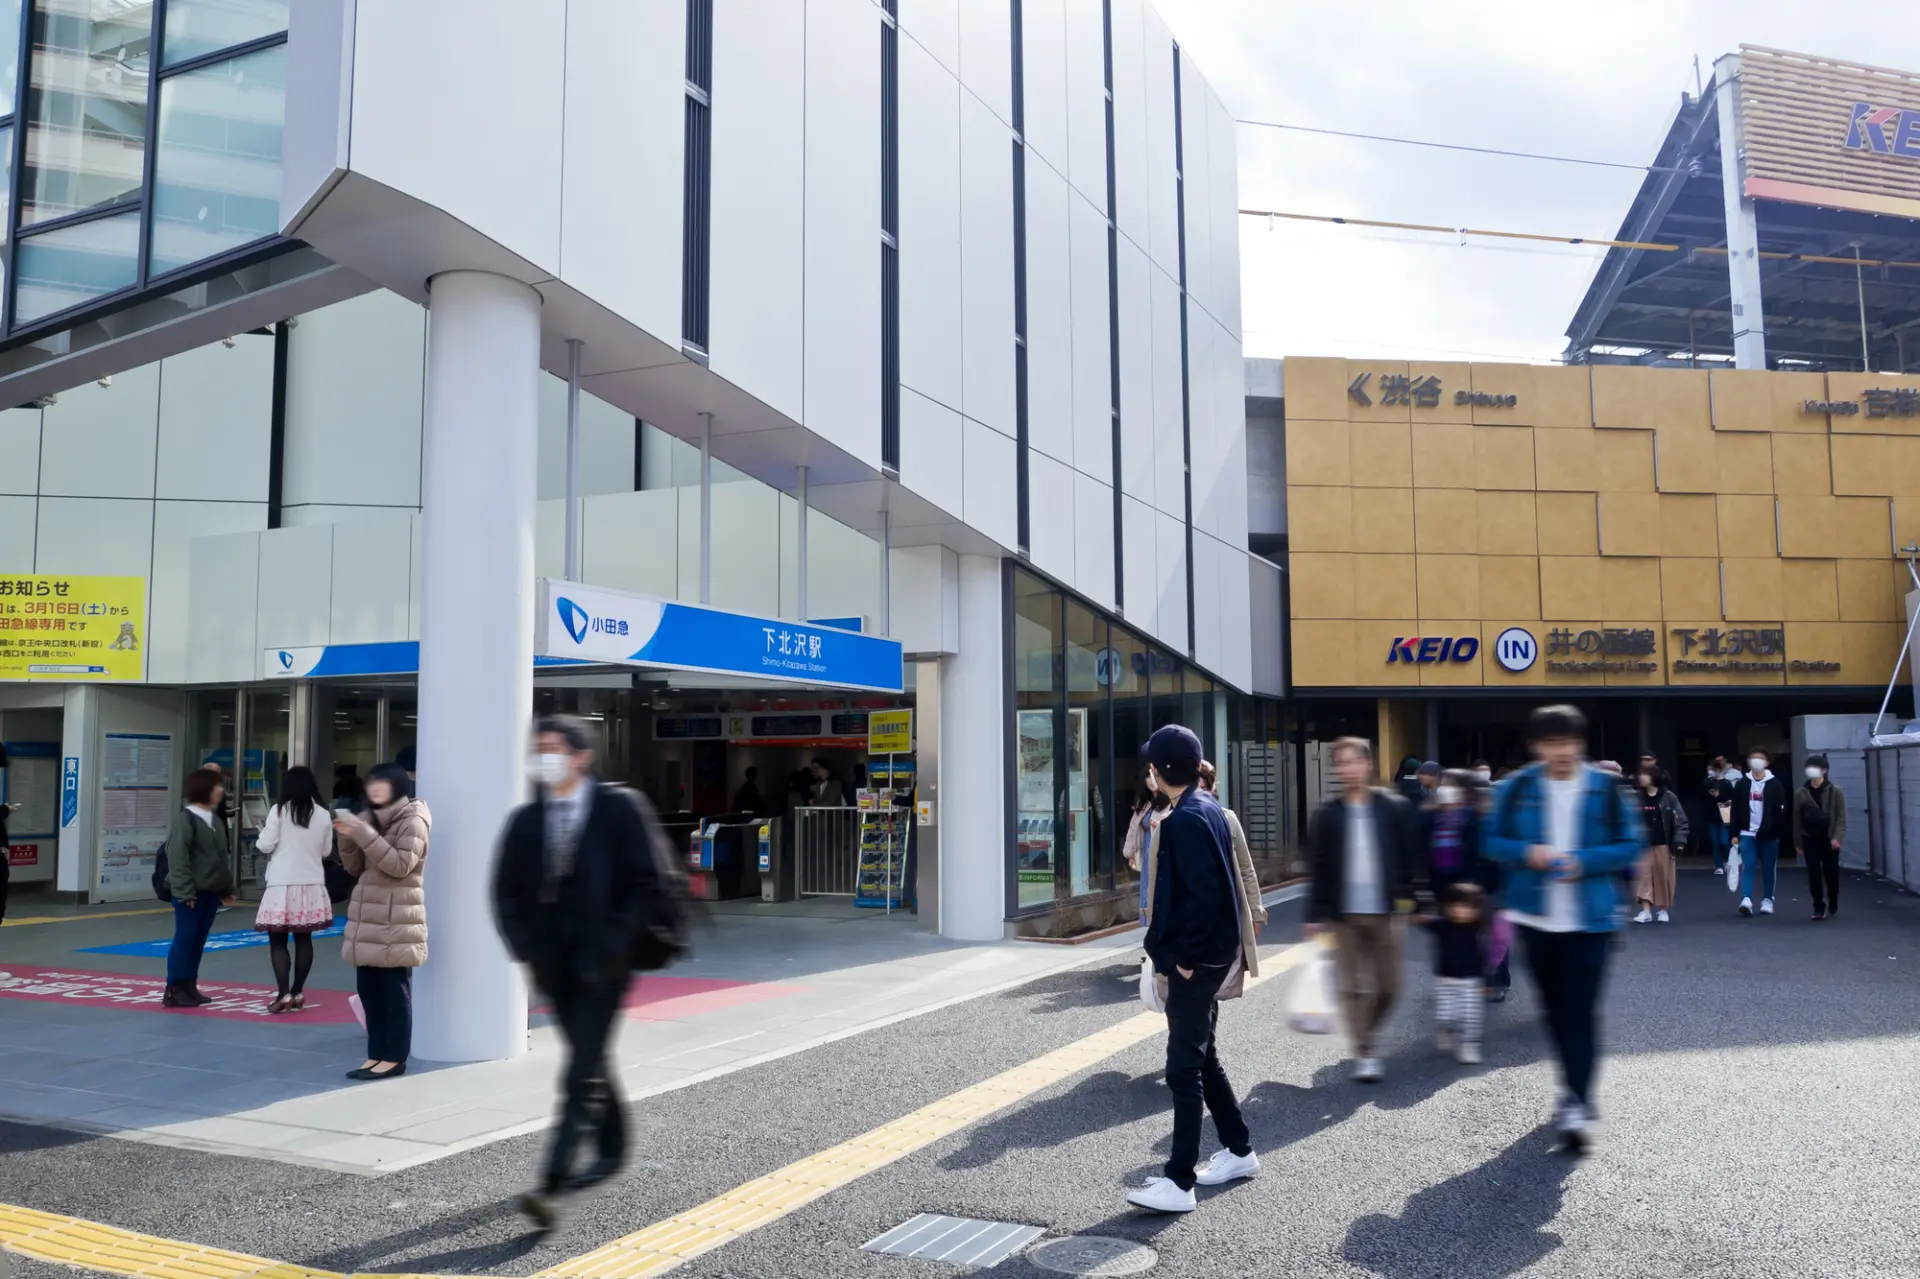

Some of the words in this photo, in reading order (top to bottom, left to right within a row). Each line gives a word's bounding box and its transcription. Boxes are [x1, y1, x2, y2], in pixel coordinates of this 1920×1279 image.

[1380, 374, 1442, 407] 渋谷
[592, 617, 629, 636] 小田急
[0, 649, 75, 658] 西口をご利用ください
[762, 627, 821, 658] 下北沢駅
[1386, 637, 1479, 663] KEIO
[1504, 640, 1529, 659] IN
[1547, 627, 1656, 655] 井の頭線
[1672, 628, 1786, 656] 下北沢駅
[66, 759, 77, 791] 東口
